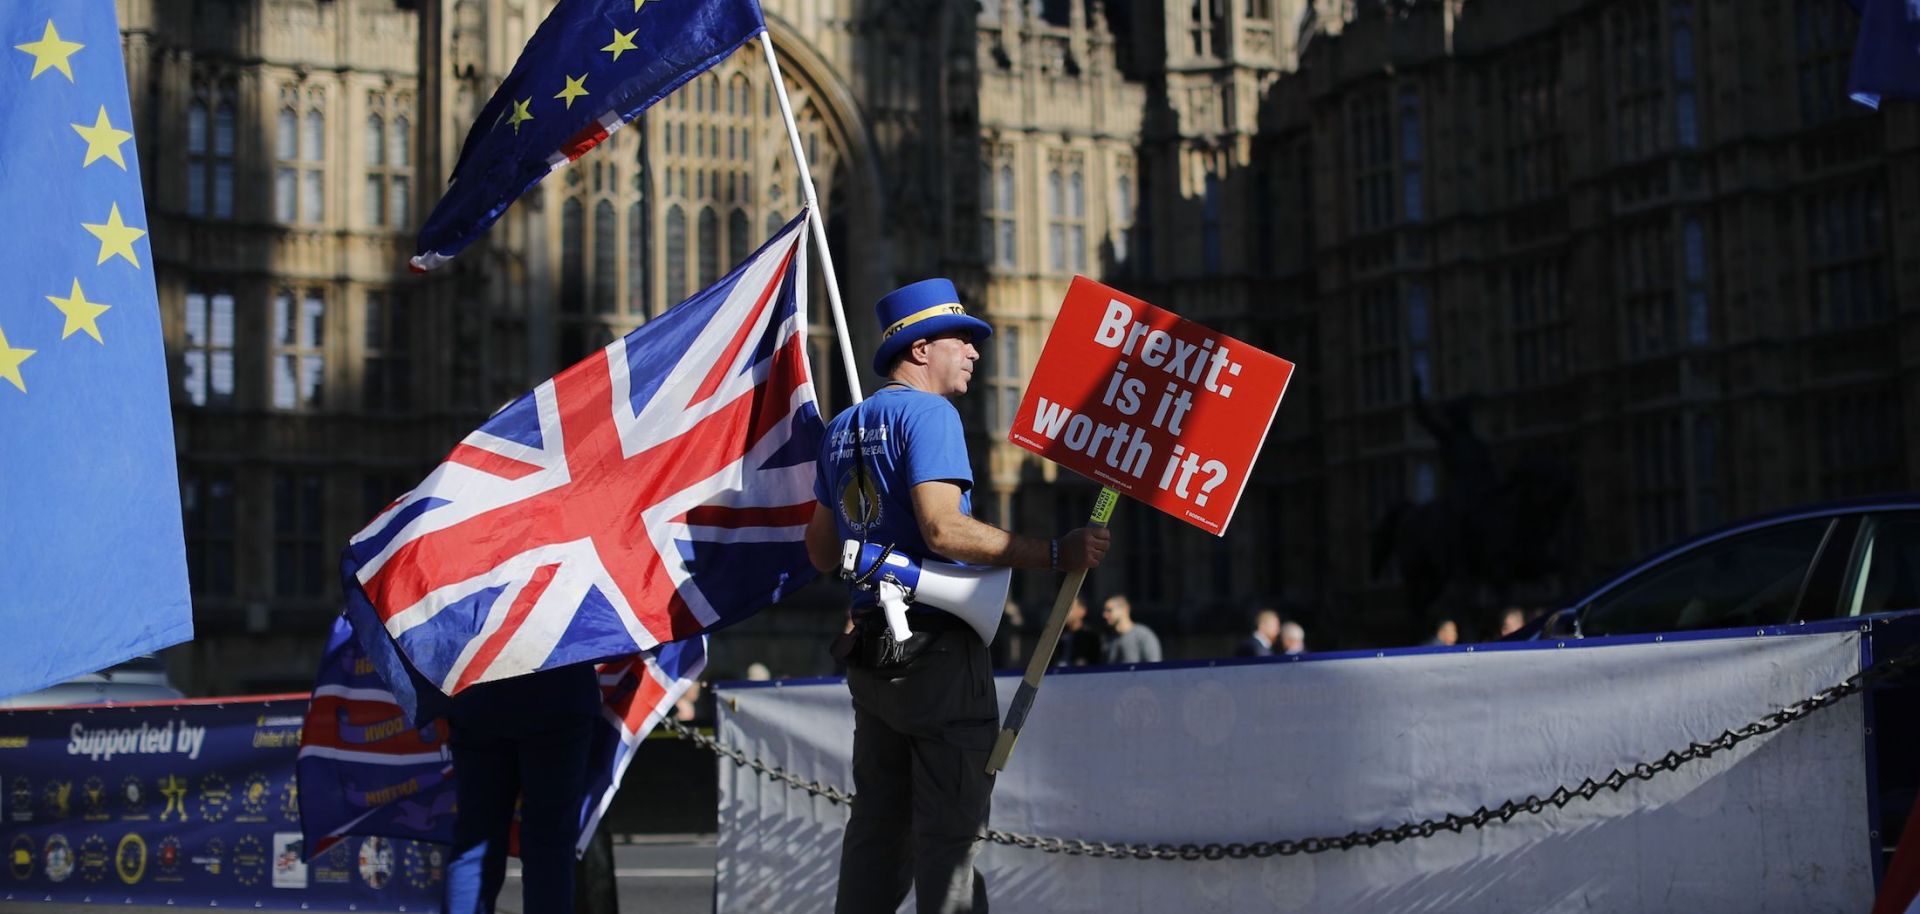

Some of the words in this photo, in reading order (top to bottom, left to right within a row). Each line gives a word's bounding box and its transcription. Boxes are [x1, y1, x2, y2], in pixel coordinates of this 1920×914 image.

[1094, 299, 1243, 398] Brexit:
[1102, 361, 1147, 416] is
[1152, 381, 1192, 436] it
[1032, 397, 1153, 479] worth
[1159, 445, 1228, 507] it?
[67, 720, 175, 761] Supported
[177, 719, 205, 760] by
